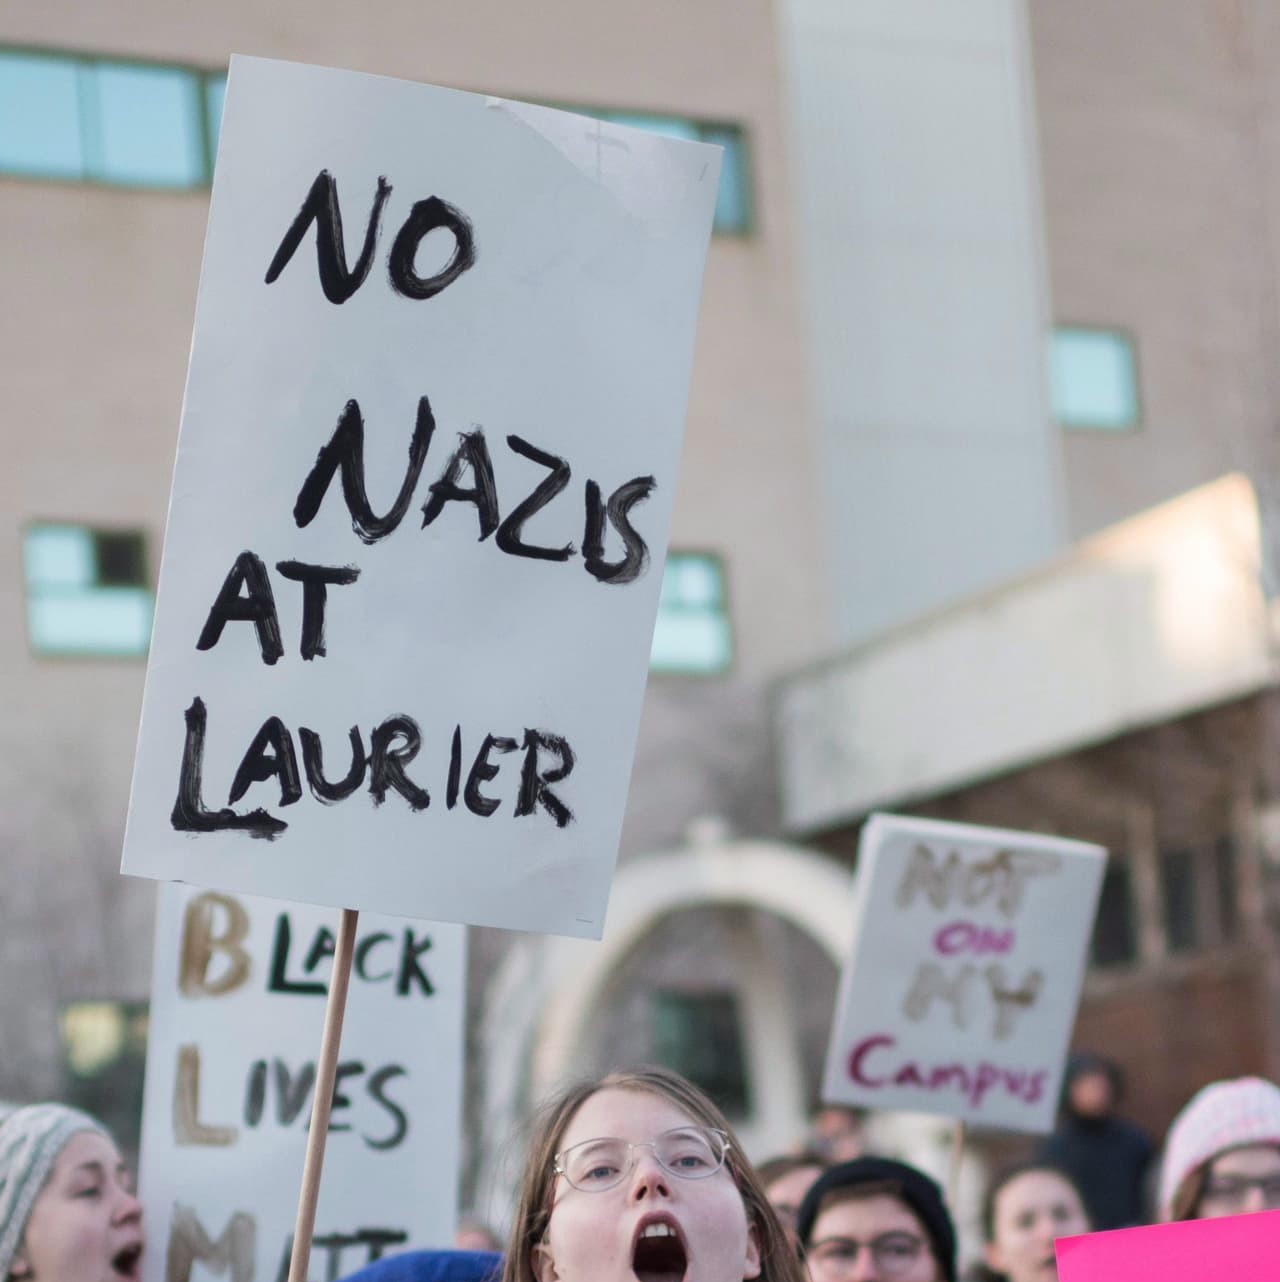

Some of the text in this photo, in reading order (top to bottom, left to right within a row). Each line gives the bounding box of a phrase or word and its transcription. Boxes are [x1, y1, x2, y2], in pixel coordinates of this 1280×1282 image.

[265, 168, 477, 304] NO
[294, 396, 656, 583] NAZIS
[196, 551, 360, 665] AT
[171, 697, 576, 840] LAURIER
[894, 842, 1063, 919] NOT
[178, 891, 436, 998] BLACK
[902, 963, 1045, 1042] MY
[172, 1042, 411, 1152] LIVES
